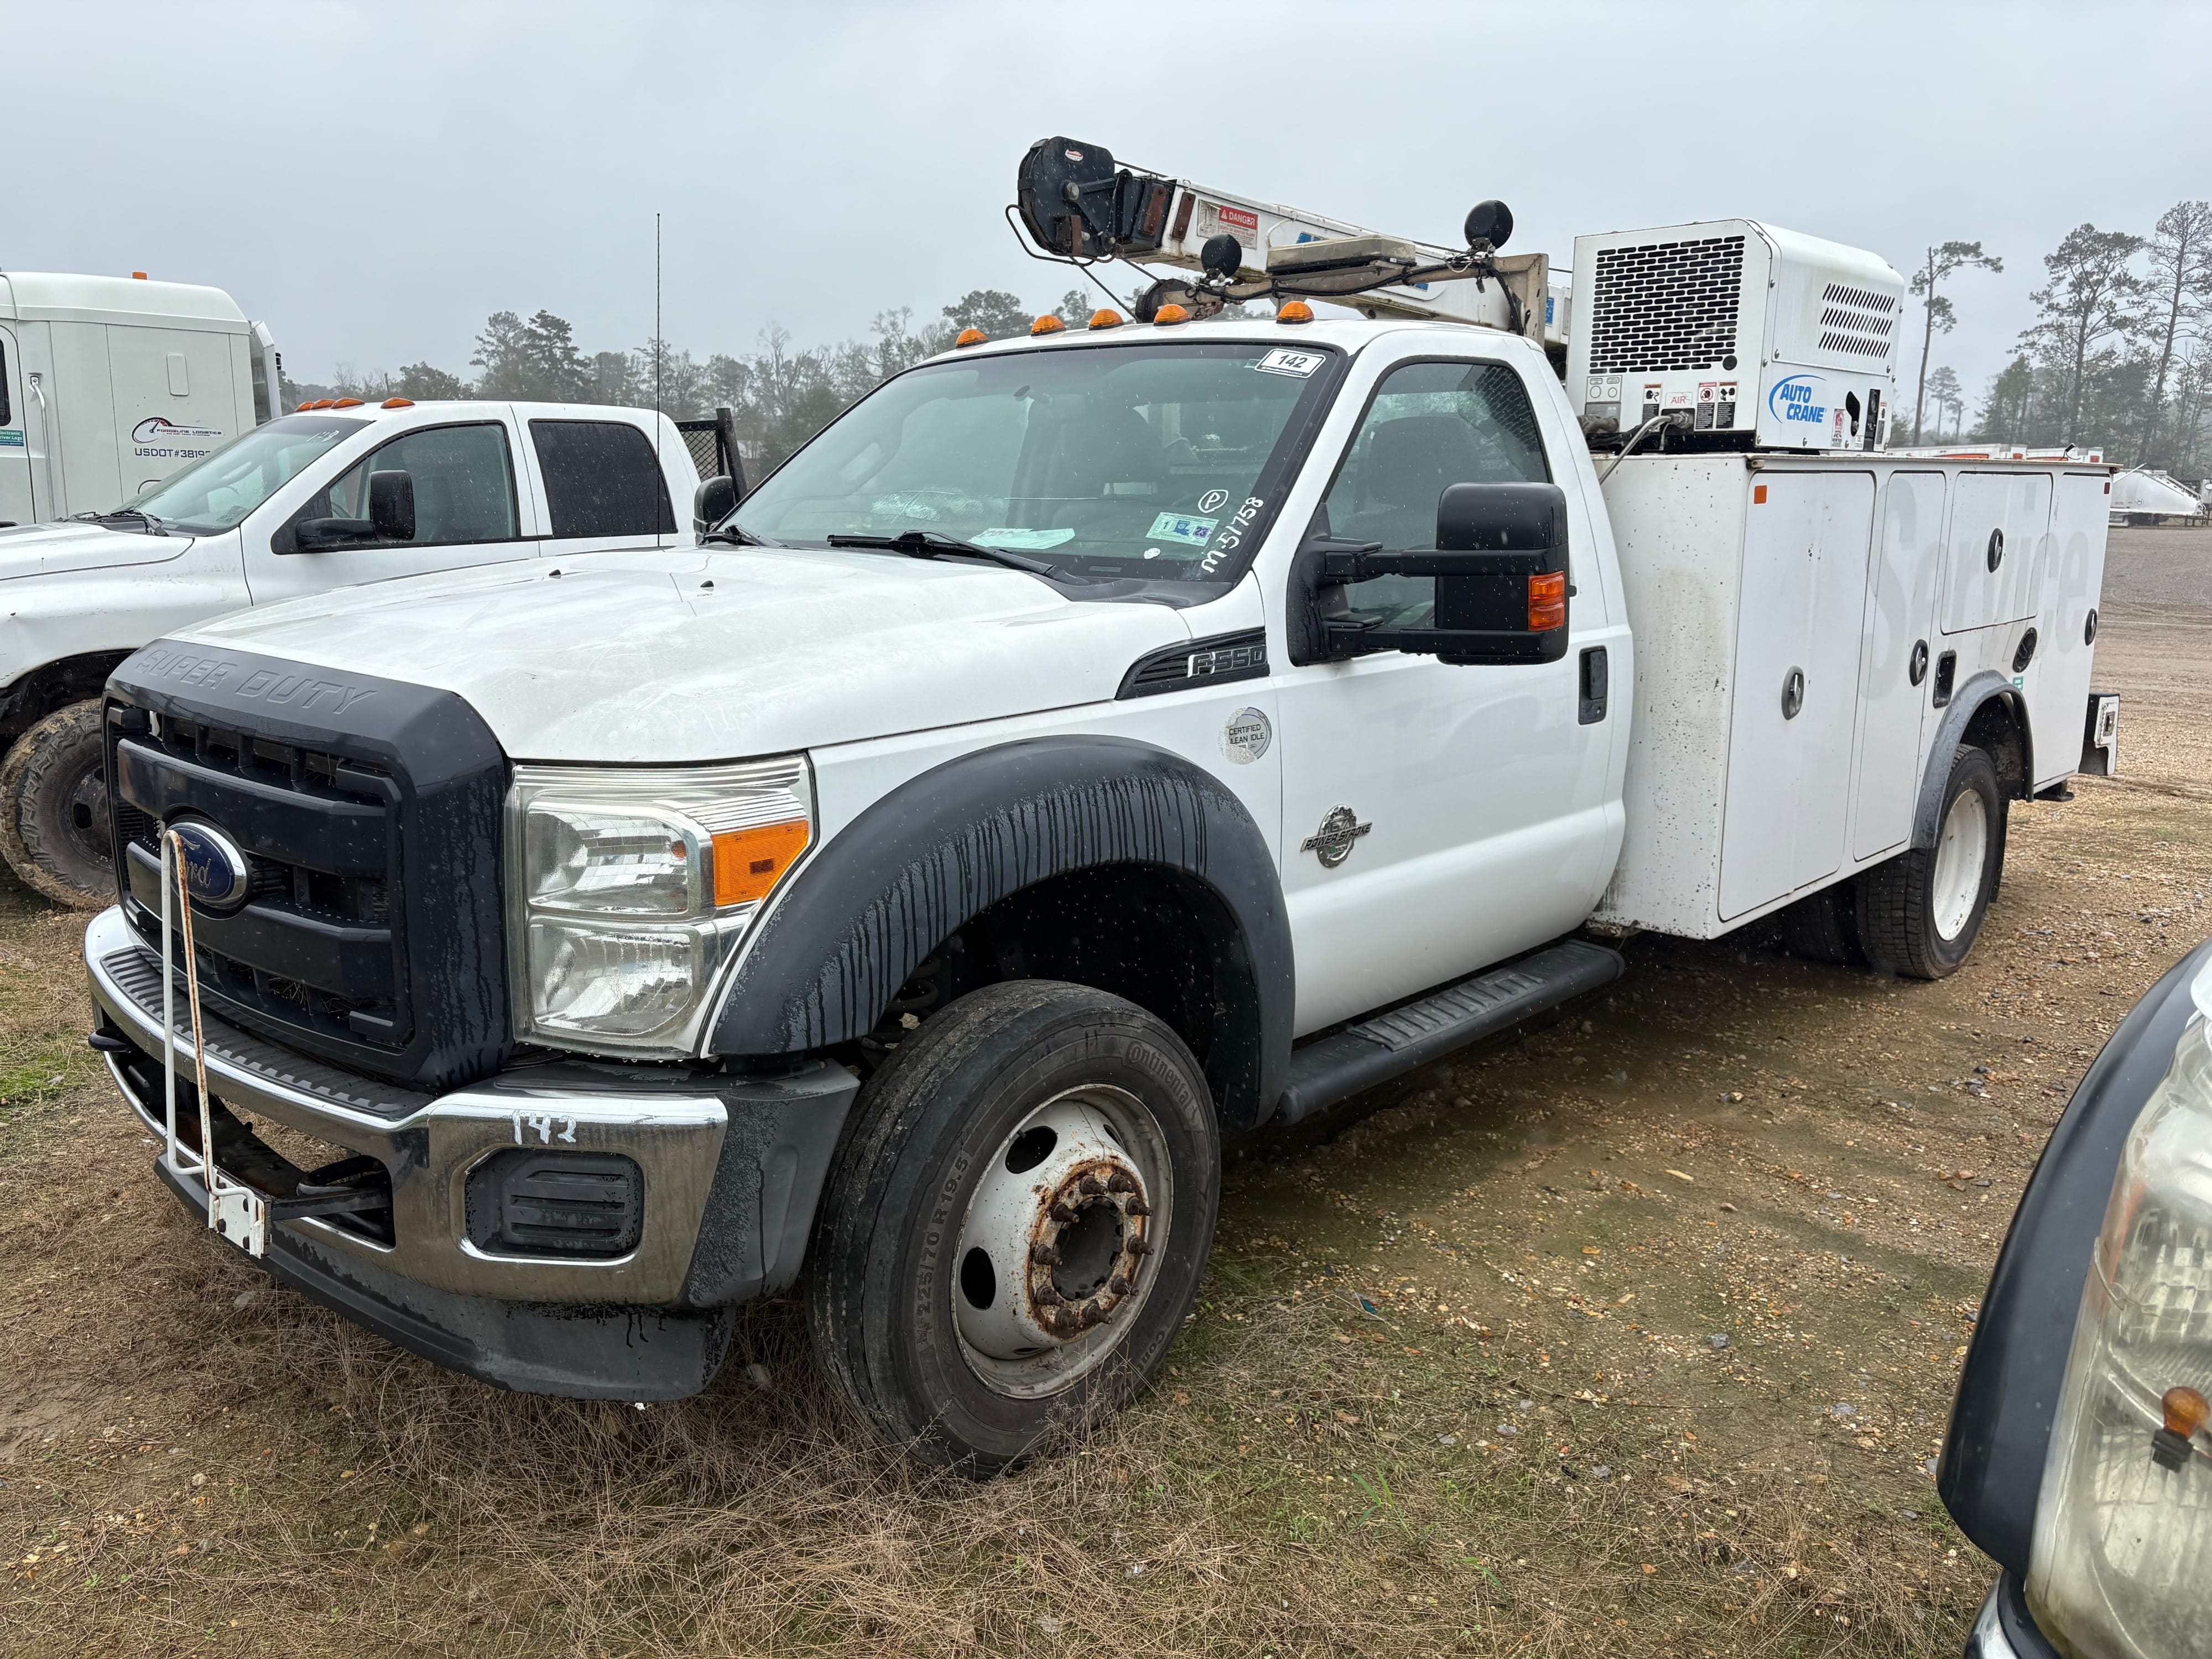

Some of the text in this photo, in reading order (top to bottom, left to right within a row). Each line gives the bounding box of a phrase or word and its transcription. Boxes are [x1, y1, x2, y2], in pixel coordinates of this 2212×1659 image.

[1229, 211, 1255, 226] DANGER
[1278, 354, 1308, 368] 142
[1779, 384, 1812, 403] AUTO
[1787, 403, 1825, 423] CRANE
[135, 447, 210, 458] USDOT#3819
[1205, 492, 1220, 509] P
[1195, 526, 1208, 536] 23
[1856, 477, 2089, 700] Service
[1188, 644, 1267, 678] F-550
[136, 650, 378, 714] SUPER DUTY
[1229, 724, 1261, 735] CERTIFIED
[1230, 732, 1264, 744] LEAN IDLE
[1304, 823, 1372, 849] POWER STROKE
[1126, 1041, 1195, 1109] Continental
[512, 1109, 576, 1145] 142
